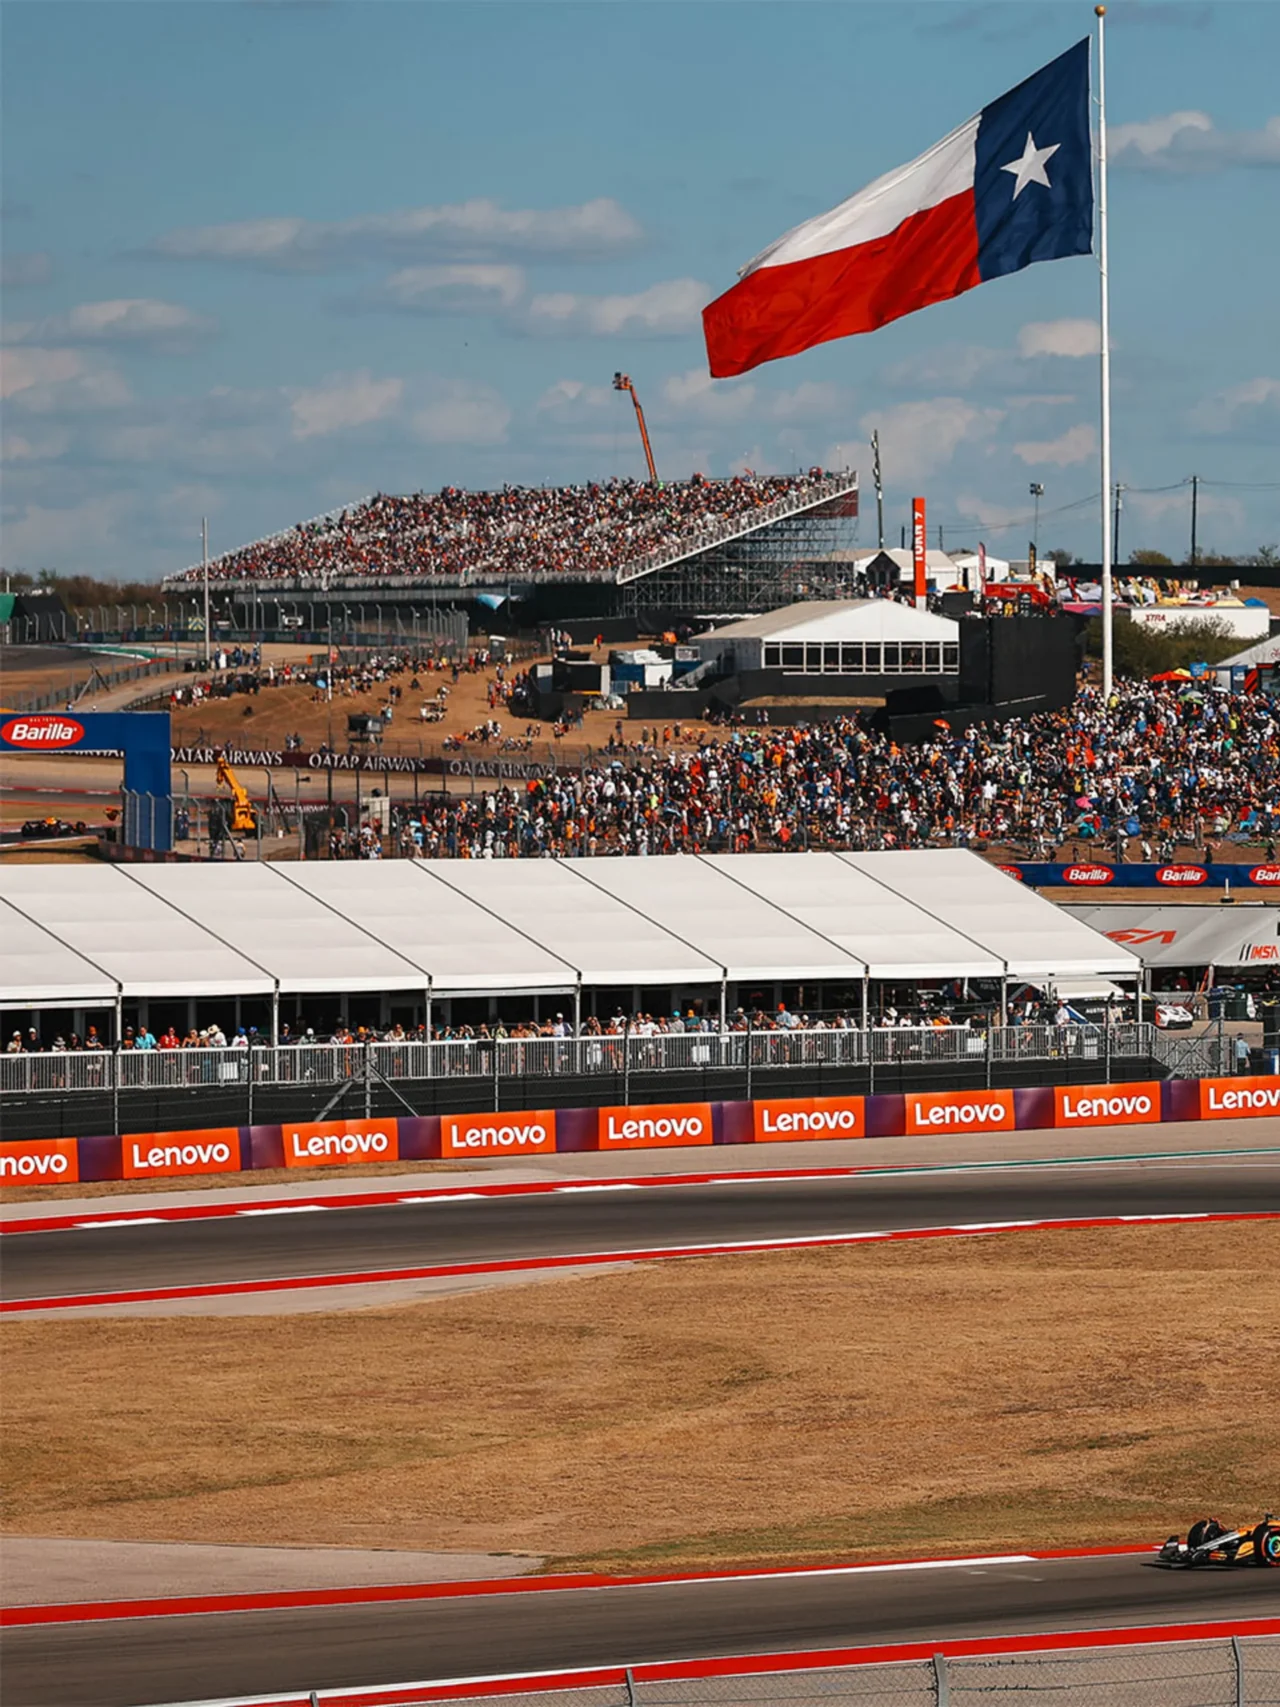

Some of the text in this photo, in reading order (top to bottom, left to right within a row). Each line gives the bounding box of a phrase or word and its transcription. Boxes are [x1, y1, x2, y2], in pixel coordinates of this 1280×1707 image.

[11, 723, 77, 741] Barilla
[218, 750, 283, 766] AIRWAYS
[308, 753, 360, 769] QATAR
[1069, 869, 1109, 881] Barilla
[1162, 869, 1203, 881] Barilla
[1250, 945, 1279, 959] IMSA
[915, 1102, 1005, 1125] Lenovo
[1063, 1094, 1151, 1118] Lenovo
[608, 1117, 703, 1140] Lenovo
[763, 1109, 855, 1132] Lenovo
[293, 1133, 388, 1158] Lenovo
[451, 1125, 546, 1148] Lenovo
[0, 1153, 68, 1176] novo
[133, 1143, 230, 1169] Lenovo
